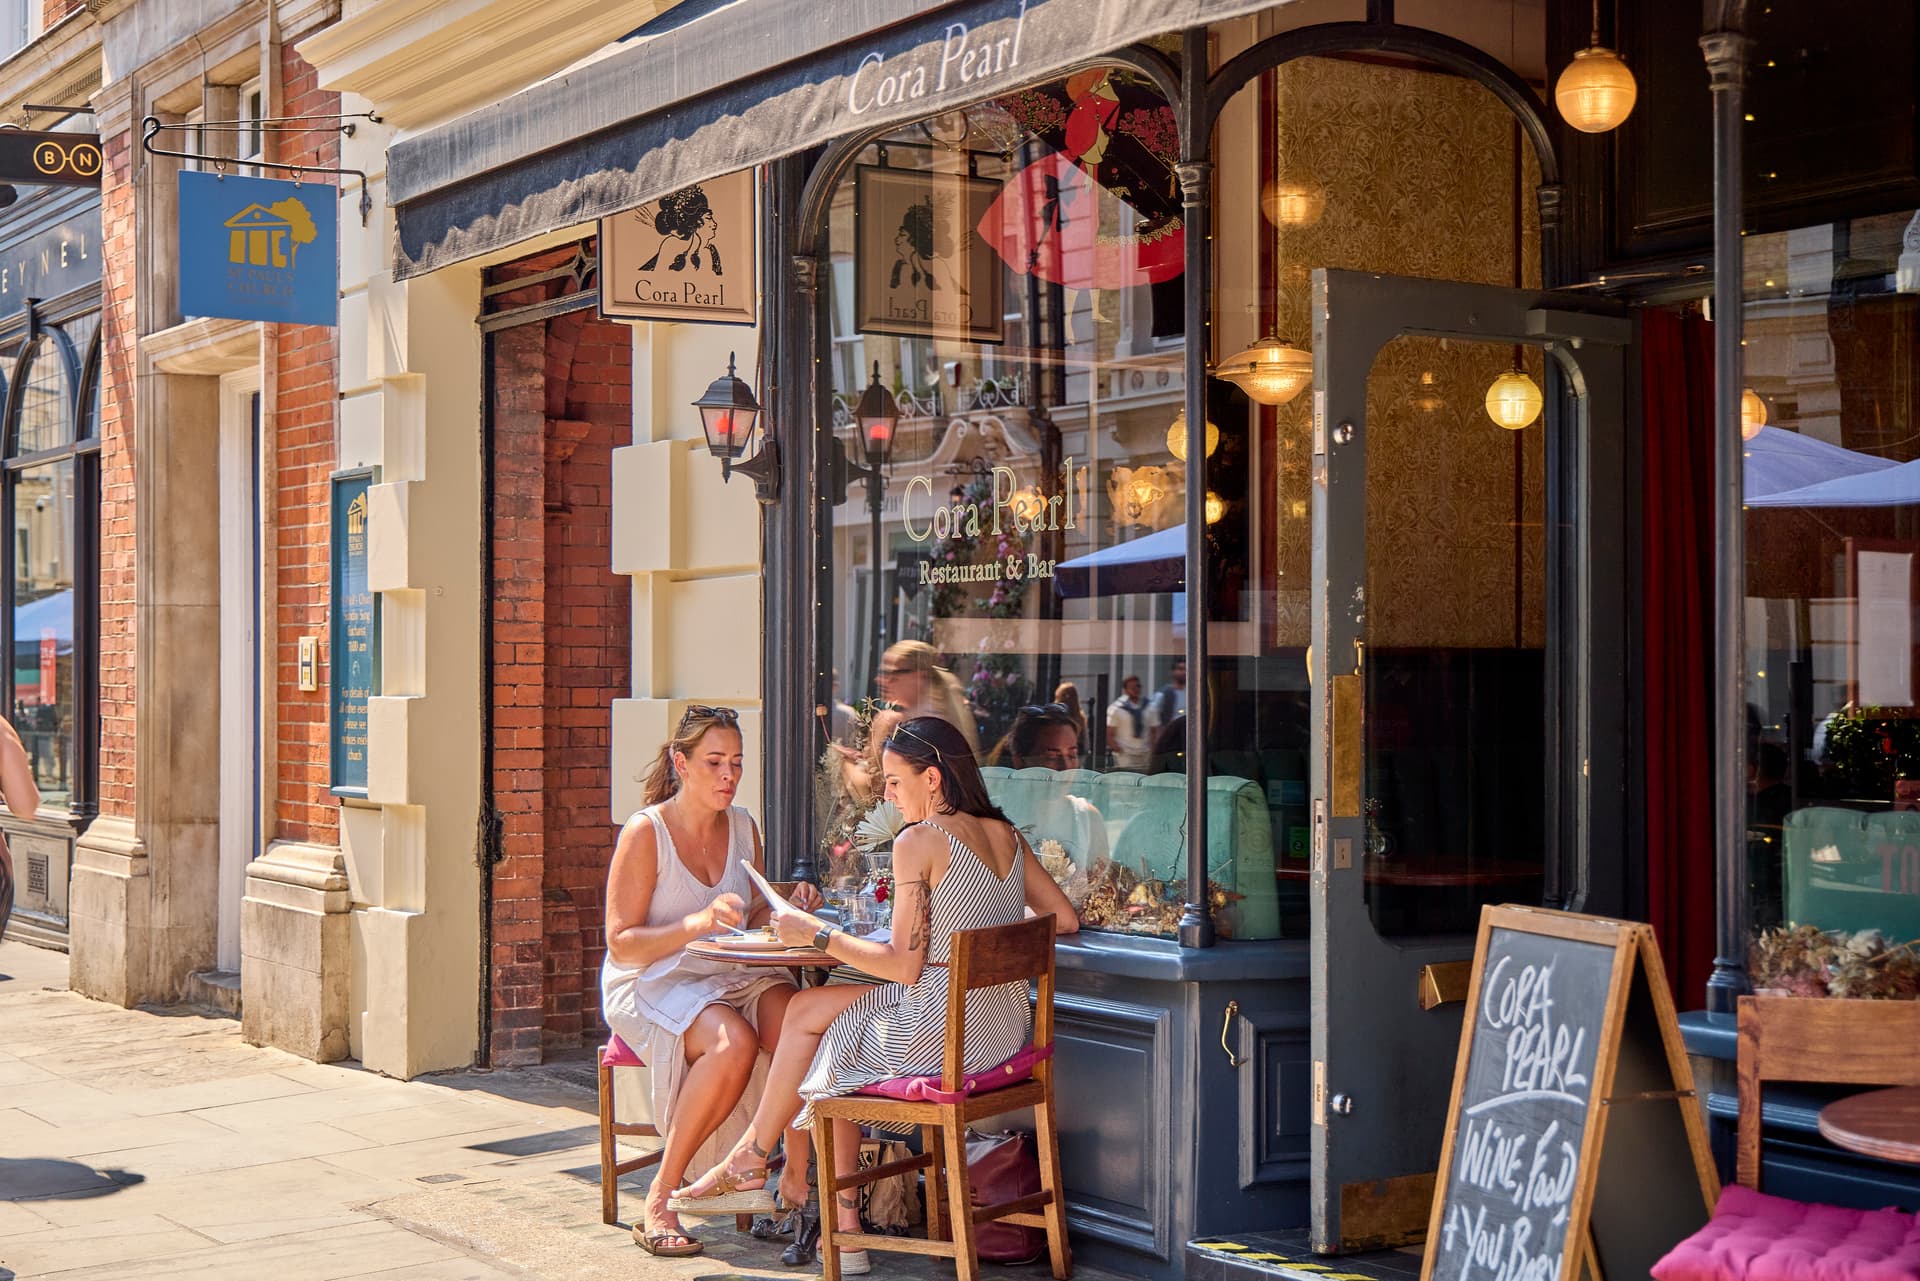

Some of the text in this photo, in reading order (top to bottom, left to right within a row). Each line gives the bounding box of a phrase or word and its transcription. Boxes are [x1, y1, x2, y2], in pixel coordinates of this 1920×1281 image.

[849, 0, 1027, 115] Cora Pearl
[635, 279, 724, 305] Cora Pearl
[902, 456, 1076, 542] Cora Pearl
[919, 560, 1001, 585] Restaurant
[1005, 554, 1023, 581] &
[1027, 552, 1056, 579] Bar
[1502, 1022, 1587, 1093] PEARL
